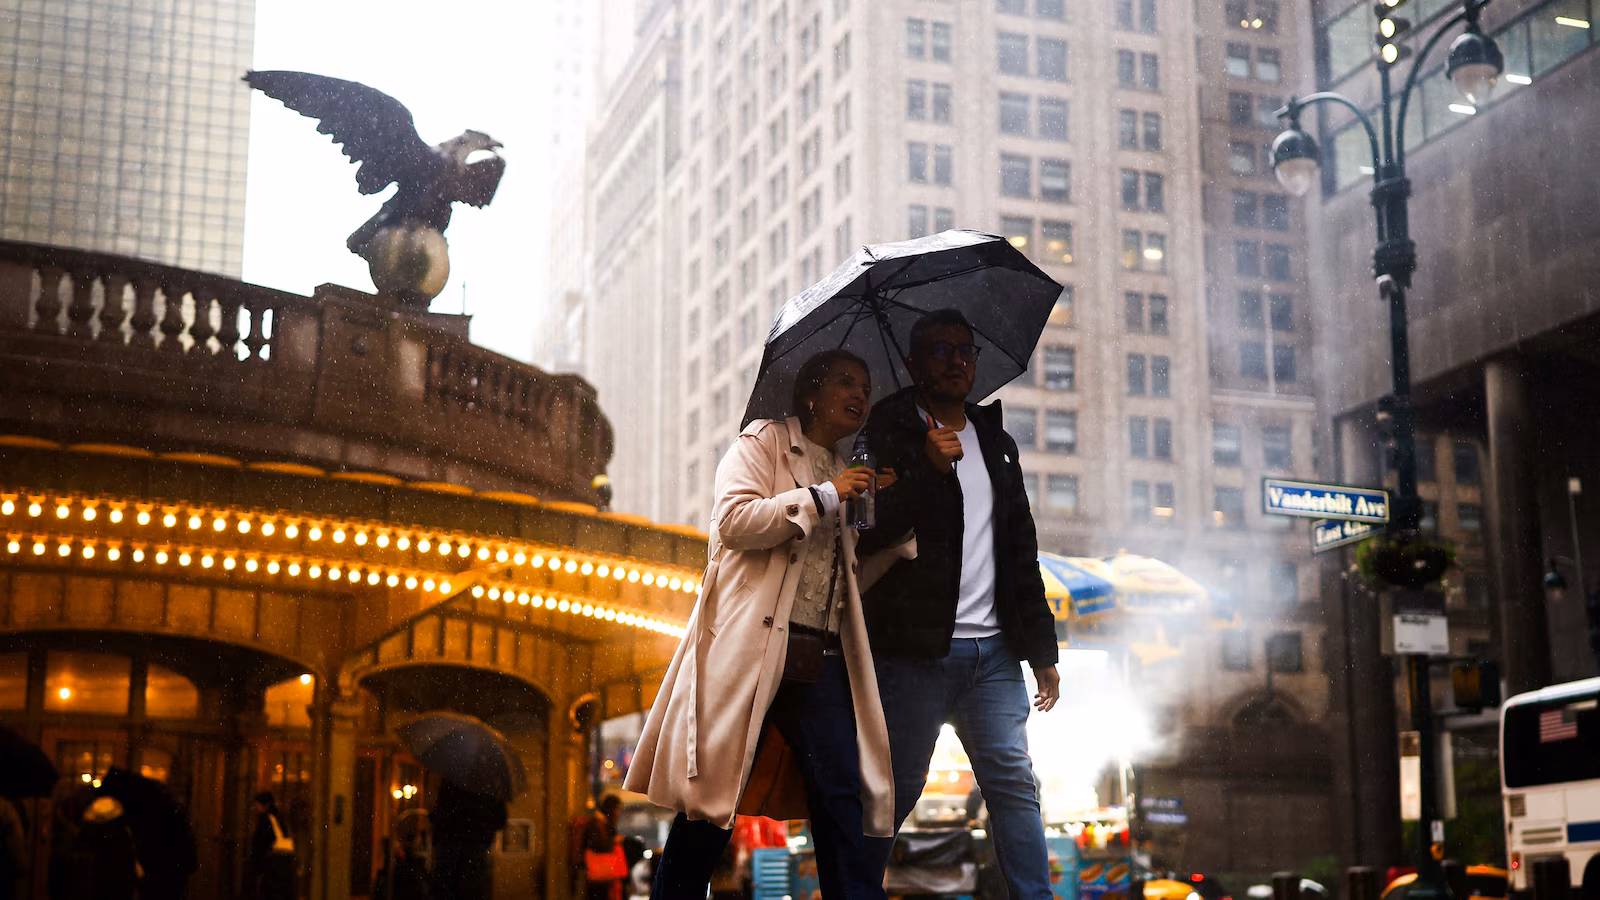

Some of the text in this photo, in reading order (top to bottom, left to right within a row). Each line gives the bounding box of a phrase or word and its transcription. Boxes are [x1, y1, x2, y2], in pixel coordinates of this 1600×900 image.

[1270, 487, 1385, 516] Vanderbilt Ave
[1316, 524, 1342, 545] East
